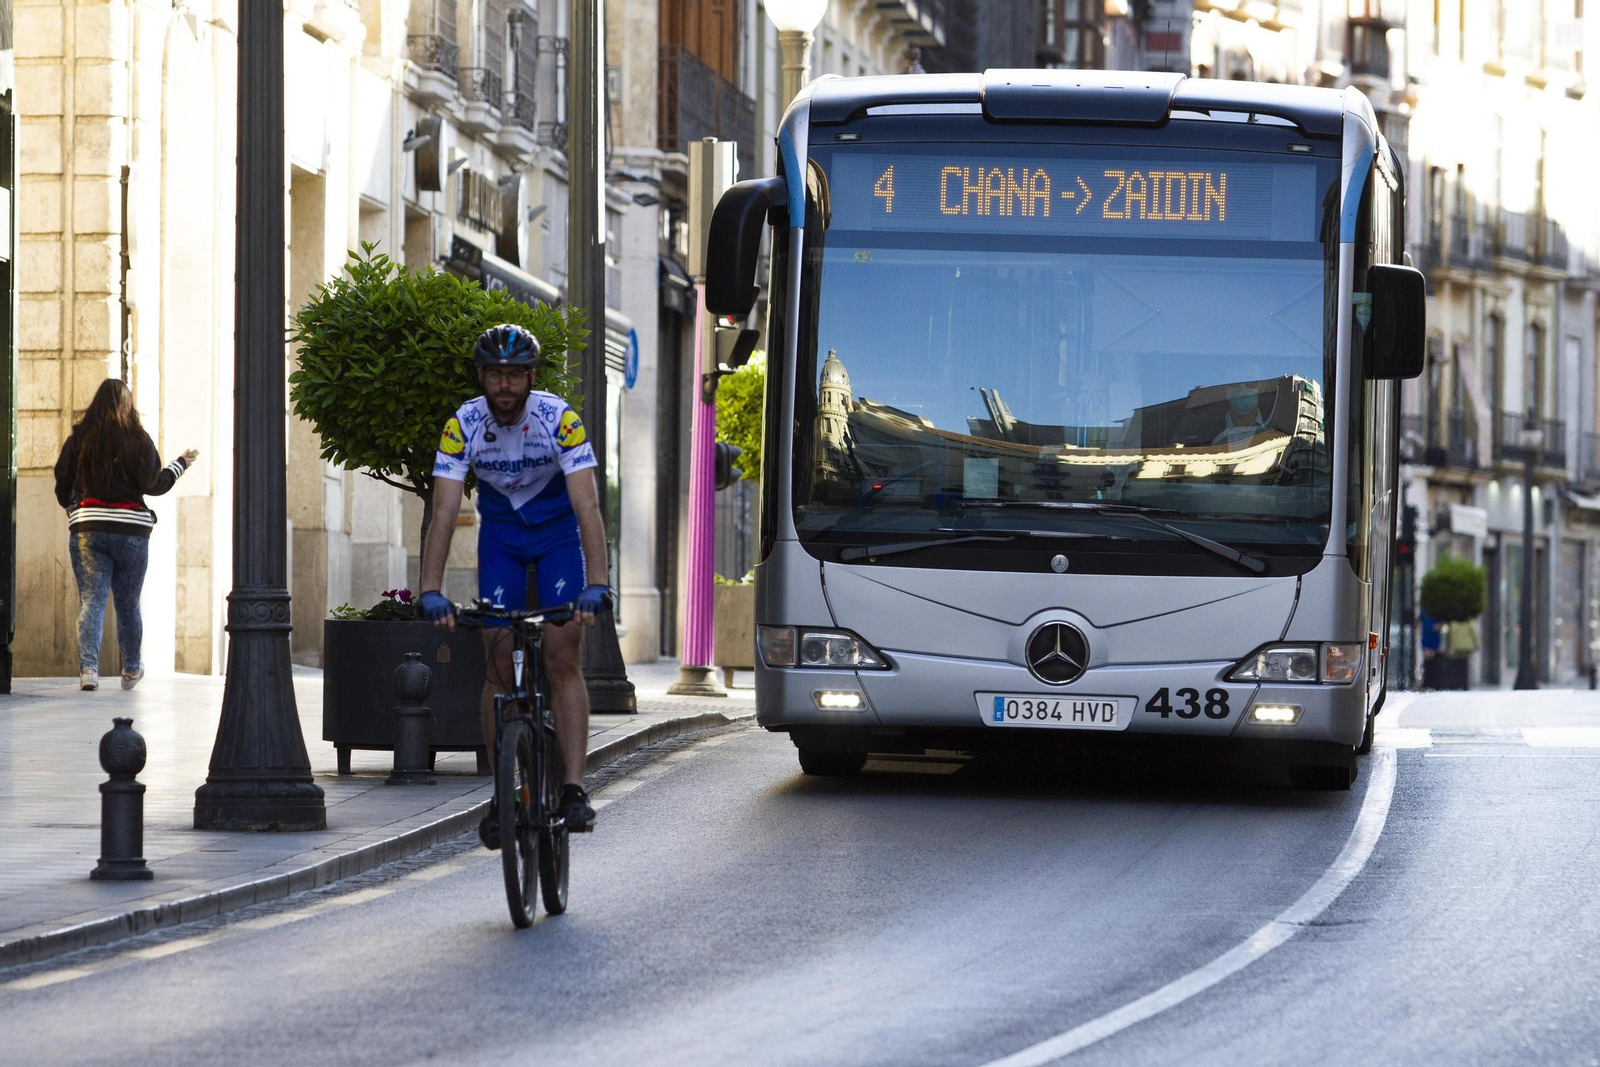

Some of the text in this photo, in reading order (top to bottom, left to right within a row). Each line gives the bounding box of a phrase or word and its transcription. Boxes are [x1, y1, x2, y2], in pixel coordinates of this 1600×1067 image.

[874, 165, 1227, 222] 4 CHANA ZAIDIN
[1006, 699, 1114, 723] 0384 HVD
[1145, 687, 1231, 719] 438
